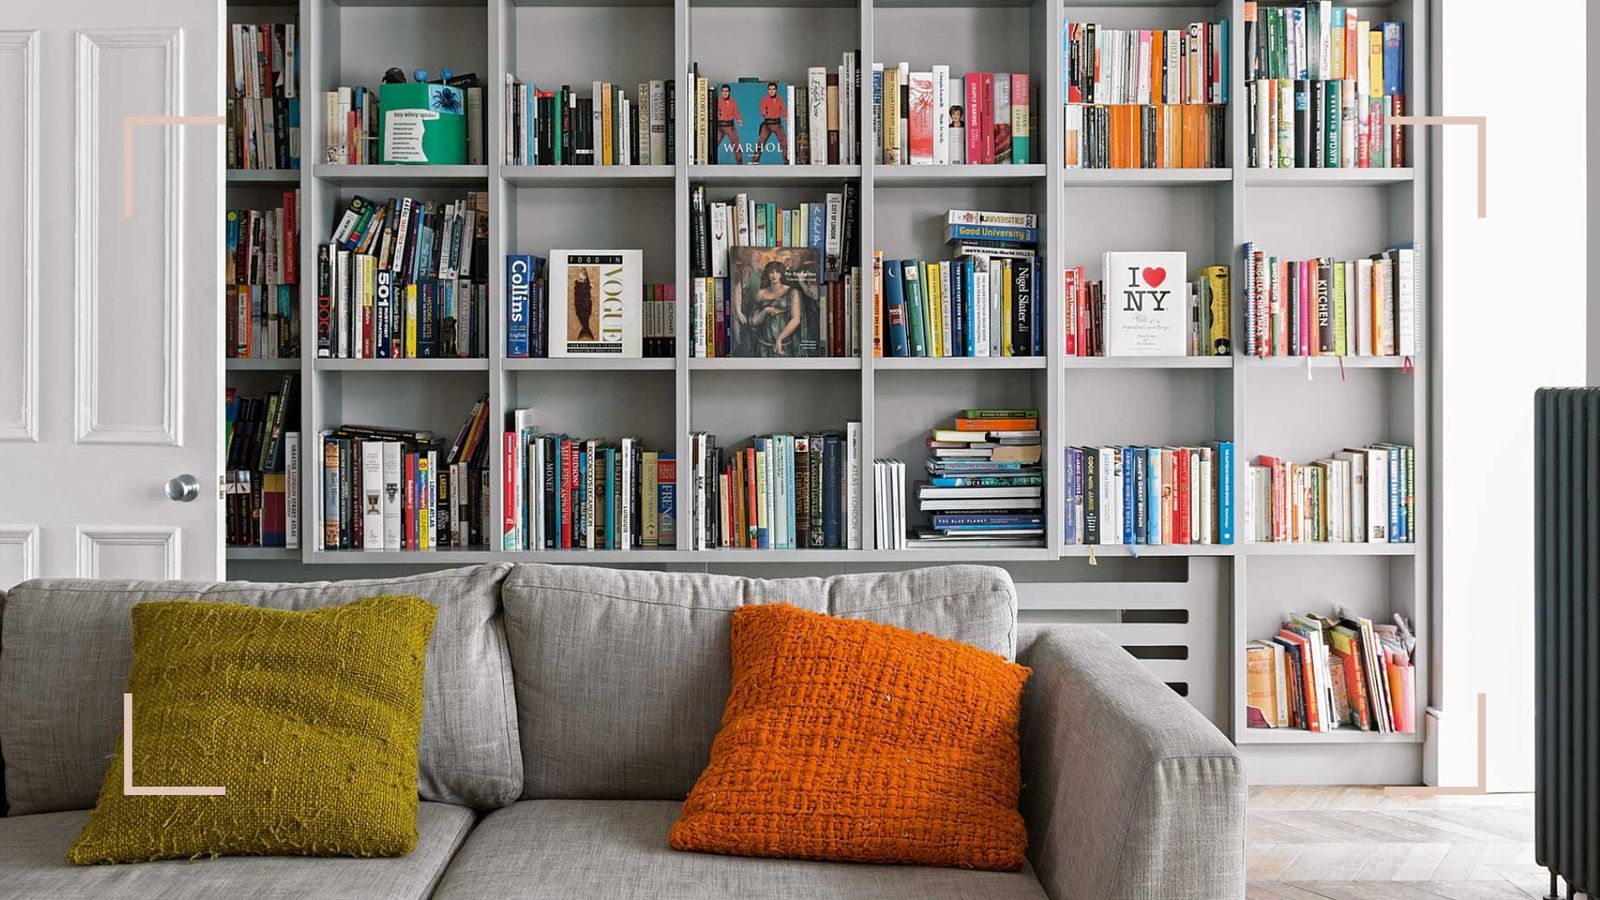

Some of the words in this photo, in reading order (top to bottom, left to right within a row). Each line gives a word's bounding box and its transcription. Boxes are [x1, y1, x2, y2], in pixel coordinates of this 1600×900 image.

[873, 71, 882, 104] JERUSALEM
[723, 143, 784, 153] WARHOL
[959, 227, 981, 236] Good
[982, 228, 1025, 241] University
[378, 271, 389, 307] 501
[511, 260, 529, 322] Collins
[1015, 267, 1029, 292] Nigel
[1128, 267, 1140, 287] I
[1256, 261, 1264, 293] NIGELLA
[318, 296, 330, 334] DOG
[602, 268, 623, 342] VOGUE
[1018, 294, 1029, 322] Slater
[1123, 291, 1171, 311] NY
[1256, 294, 1264, 336] CHRISTMAS
[1318, 279, 1328, 327] KITCHEN
[438, 474, 447, 499] LARSSON
[545, 462, 554, 493] MONET
[661, 485, 673, 532] FRENCH
